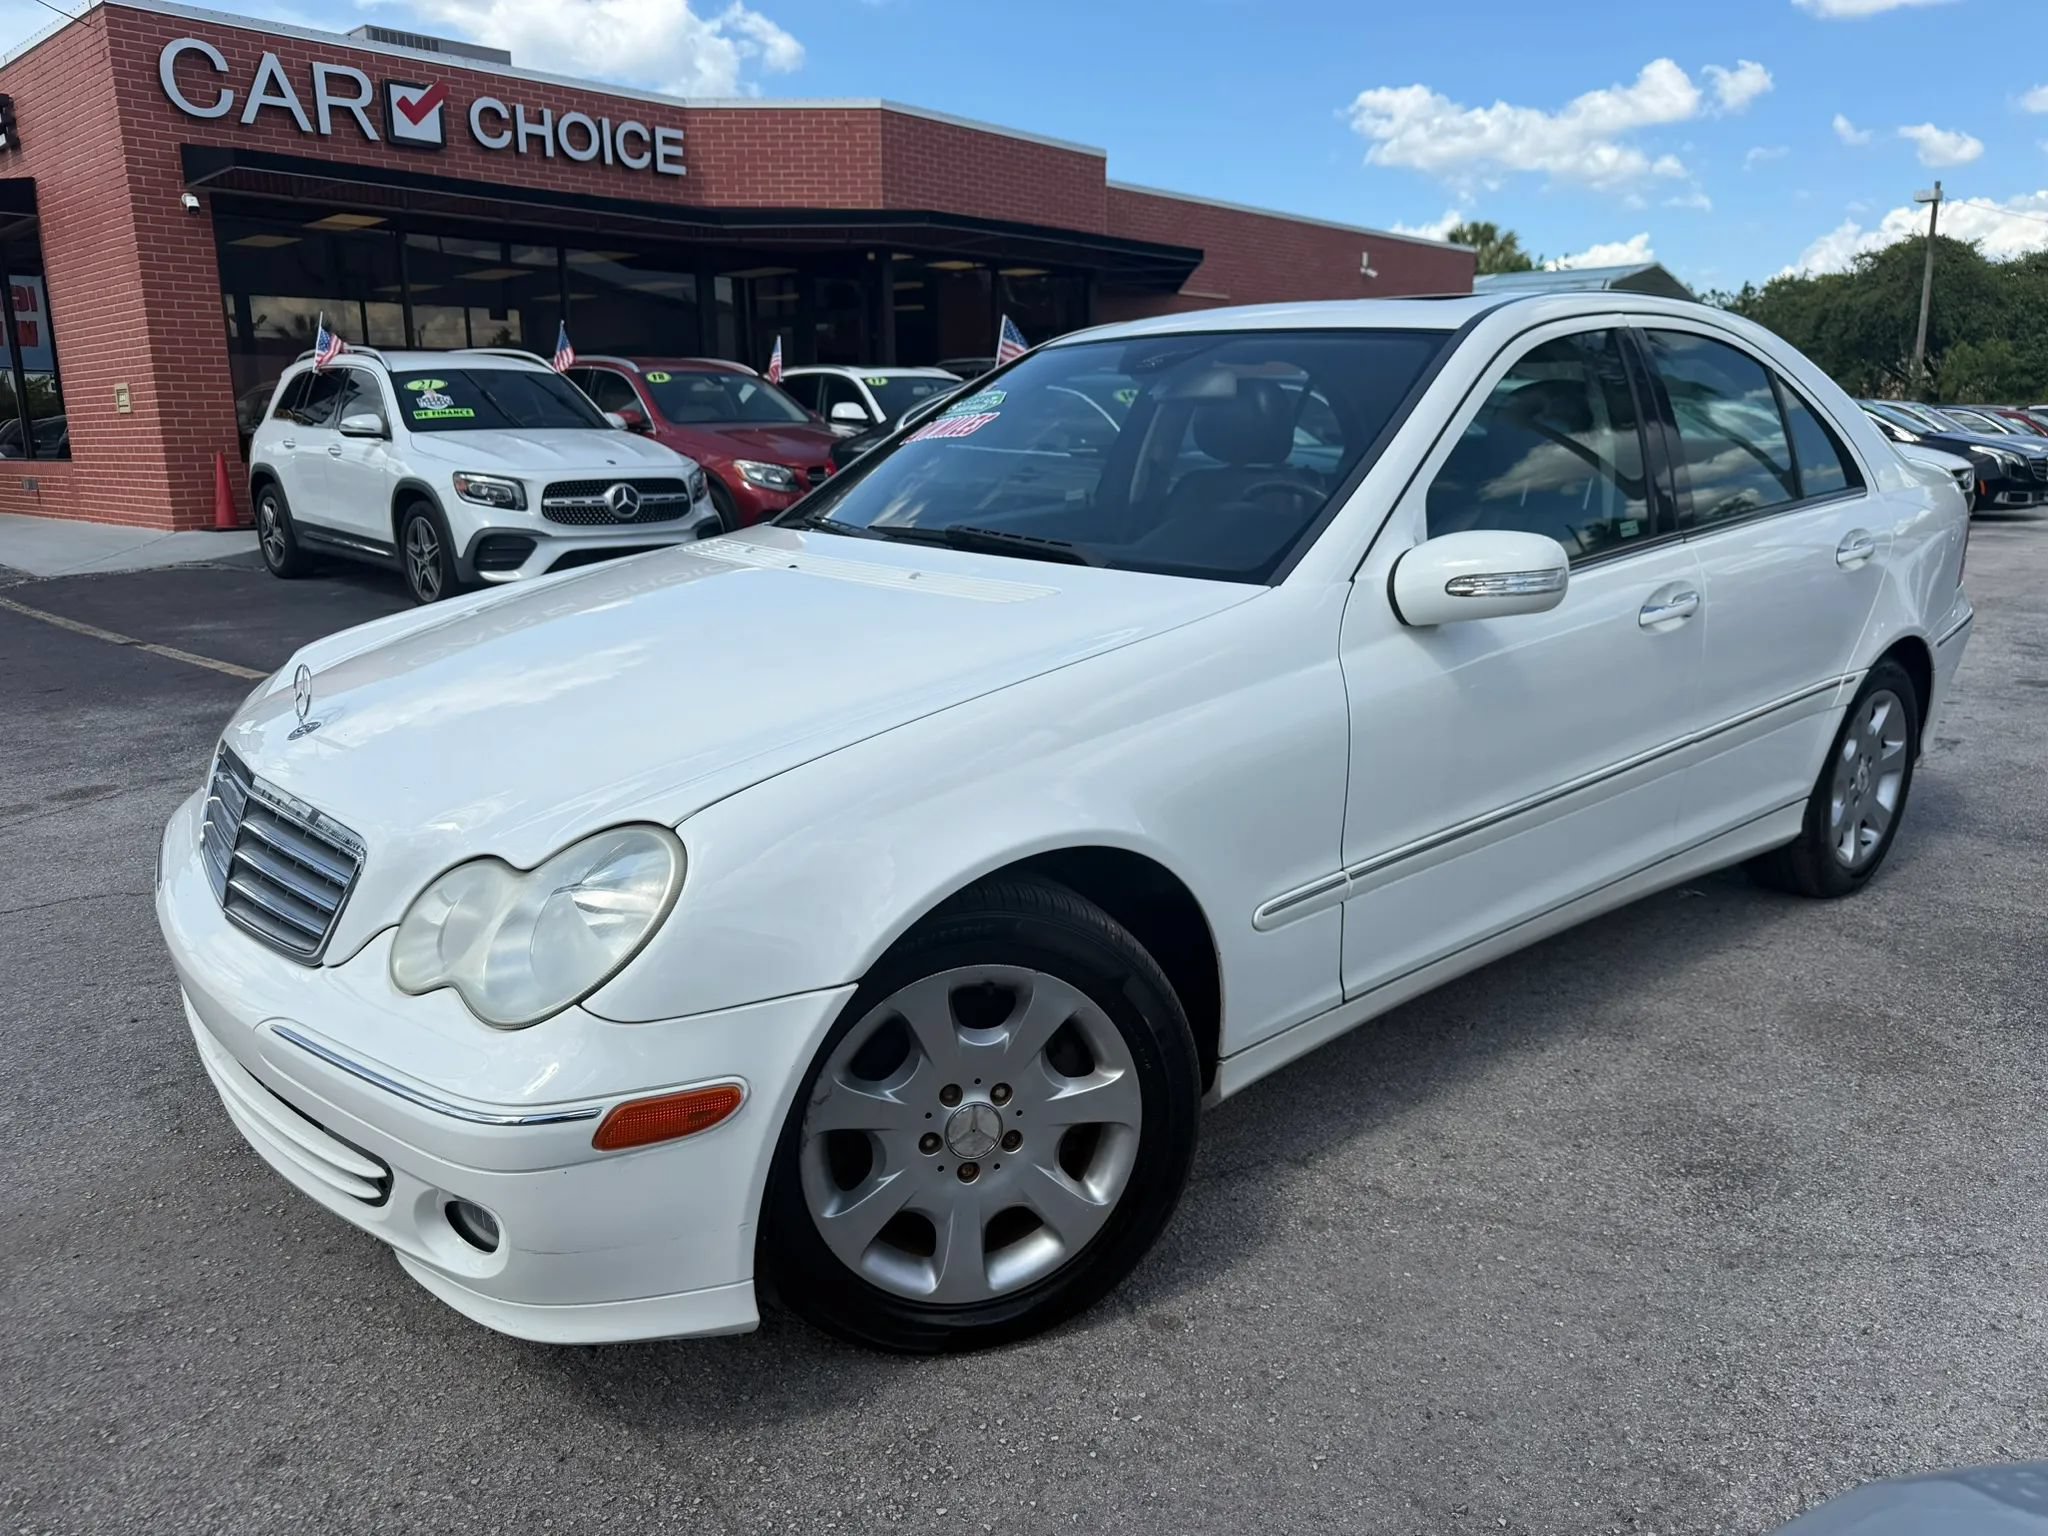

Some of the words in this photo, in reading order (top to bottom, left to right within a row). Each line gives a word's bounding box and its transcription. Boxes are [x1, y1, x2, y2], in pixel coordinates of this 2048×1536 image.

[159, 37, 380, 141] CAR
[469, 97, 687, 176] CHOICE
[418, 380, 433, 390] 21
